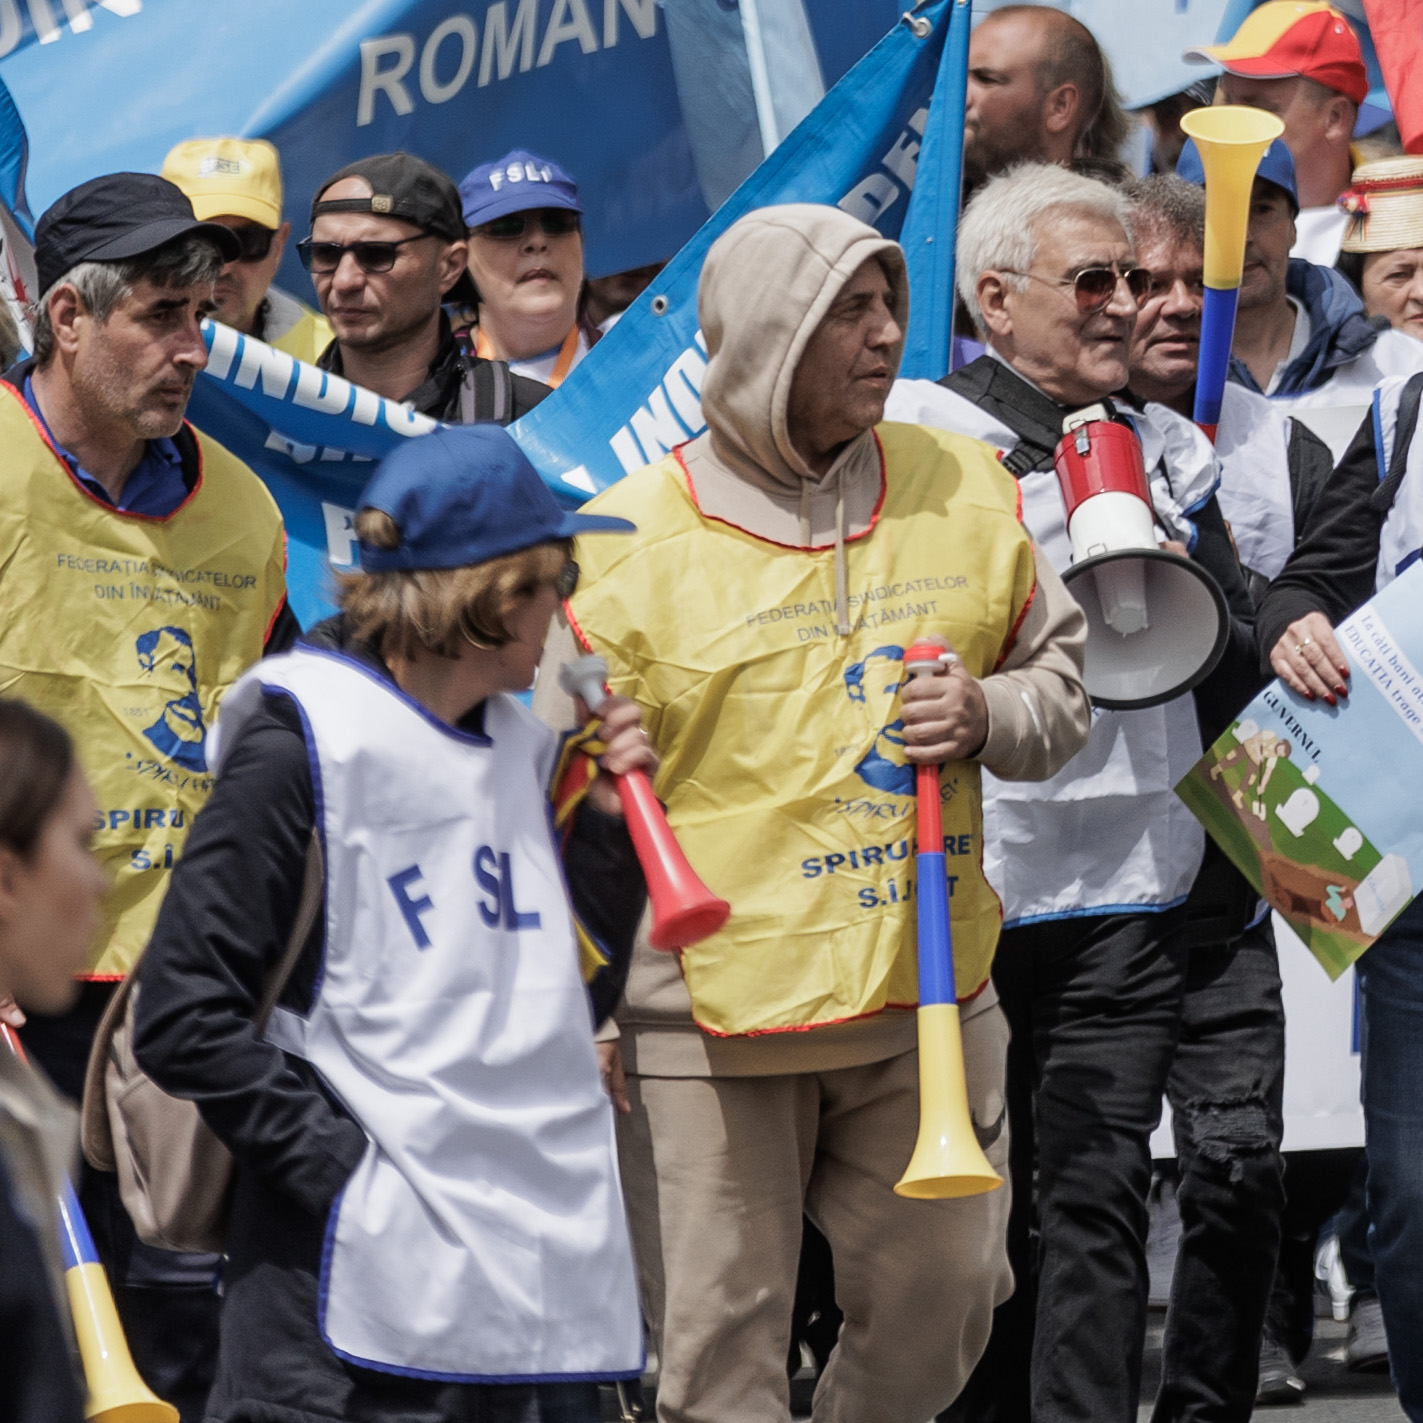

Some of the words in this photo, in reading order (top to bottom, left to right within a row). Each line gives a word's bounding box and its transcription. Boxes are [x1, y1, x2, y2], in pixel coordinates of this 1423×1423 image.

[489, 159, 553, 192] FSLI
[93, 583, 126, 601] DIN
[796, 624, 830, 643] DIN
[1388, 653, 1415, 687] bani
[1391, 688, 1422, 726] trage
[1262, 689, 1323, 764] GUVERNUL
[800, 838, 909, 880] SPIRU
